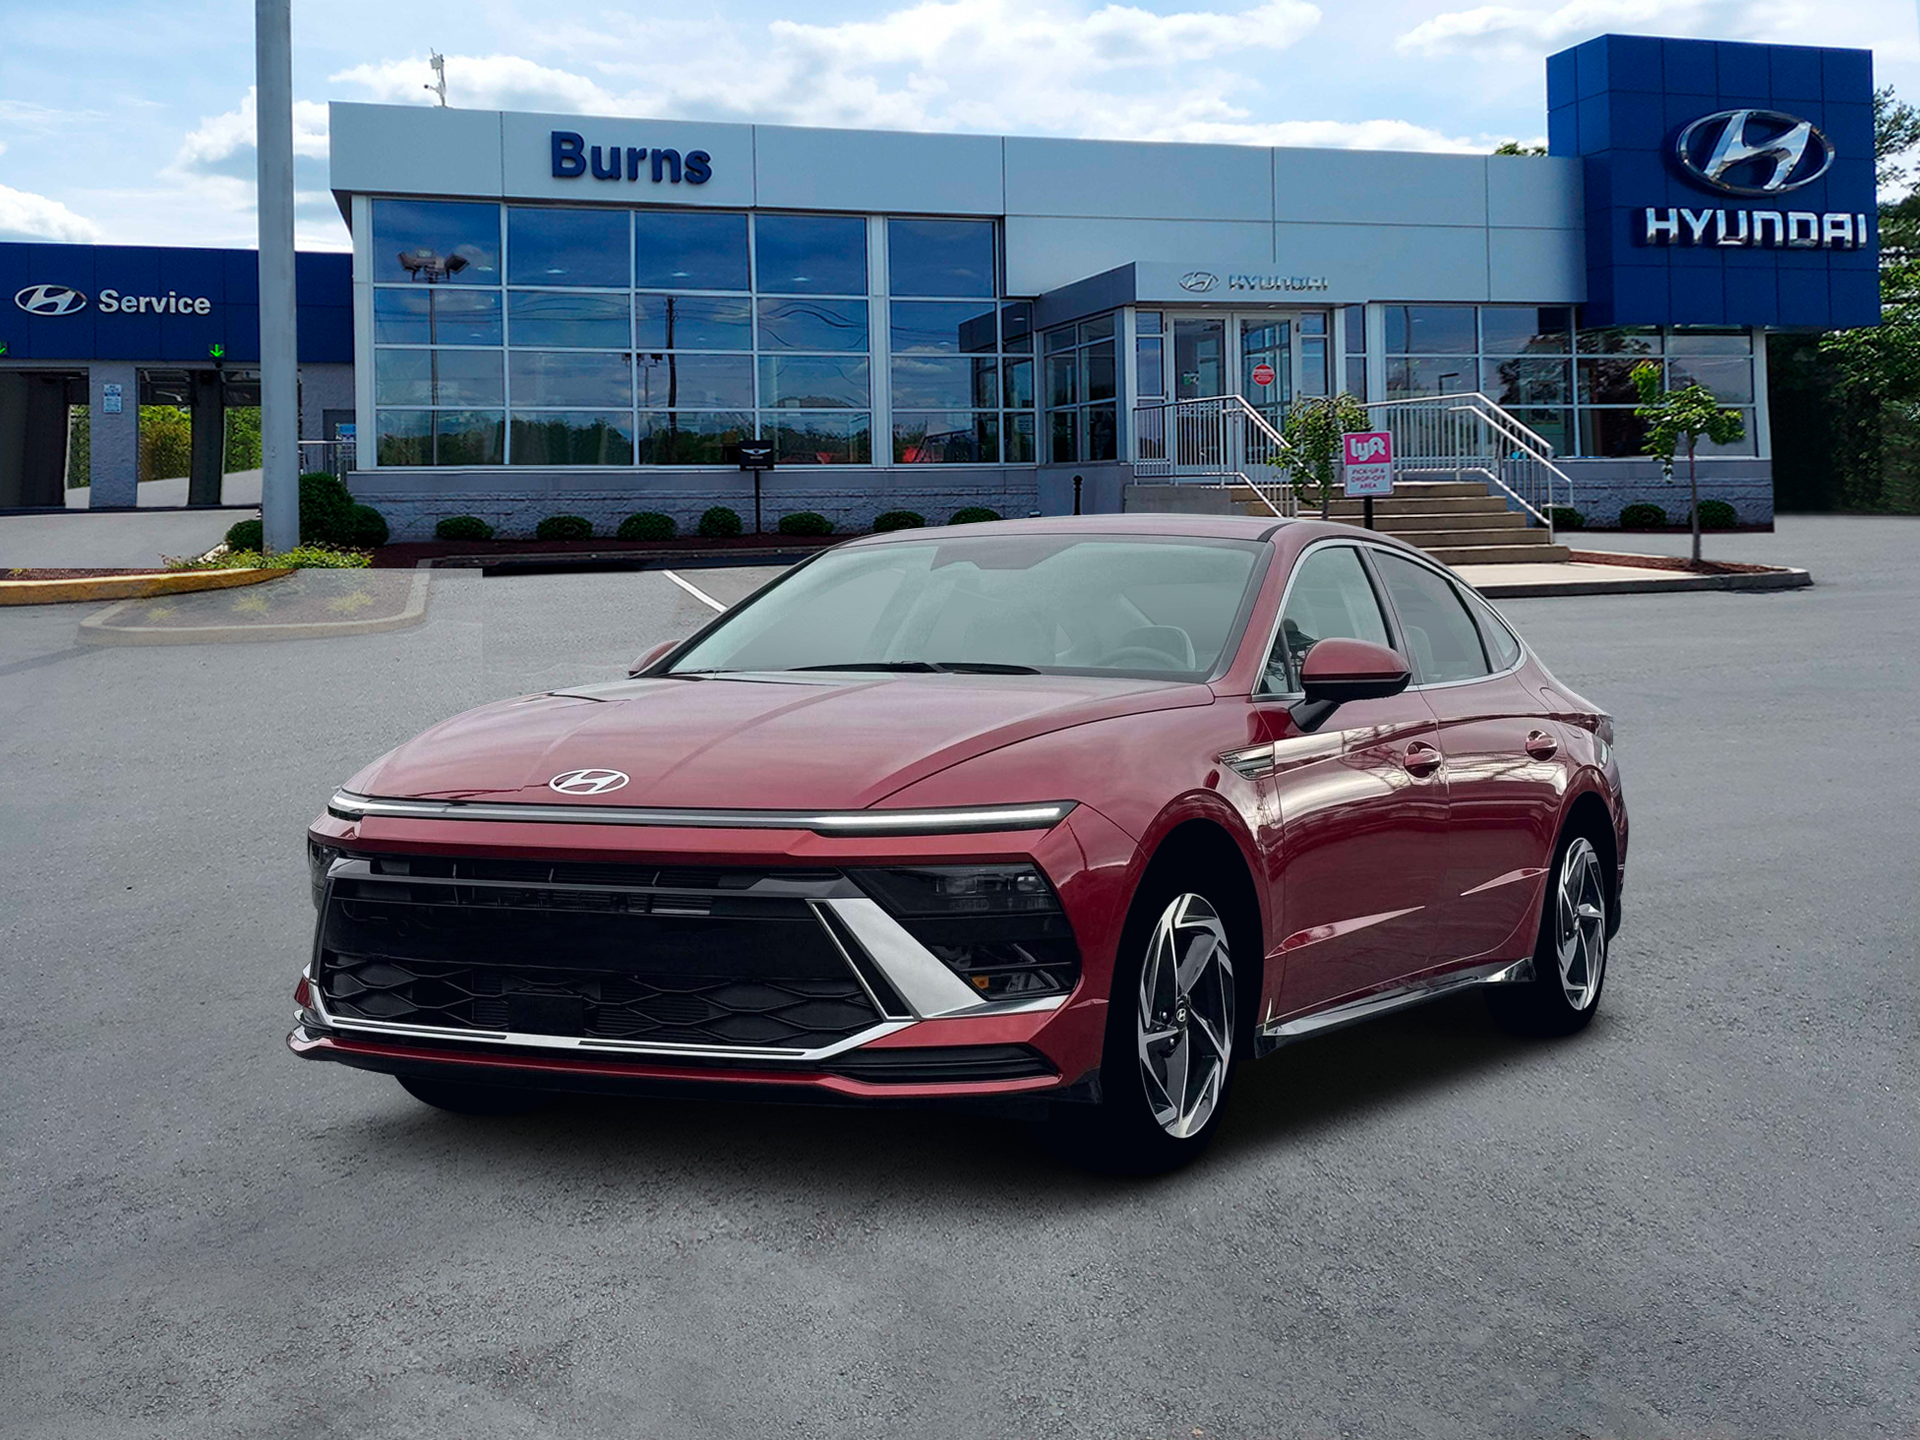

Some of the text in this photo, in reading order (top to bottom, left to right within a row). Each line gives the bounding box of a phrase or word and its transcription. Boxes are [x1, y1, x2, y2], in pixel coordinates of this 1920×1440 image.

[551, 130, 712, 185] Burns
[1645, 207, 1868, 248] HYUNDAI
[1228, 273, 1329, 291] HYUNDAI
[98, 289, 212, 315] Service
